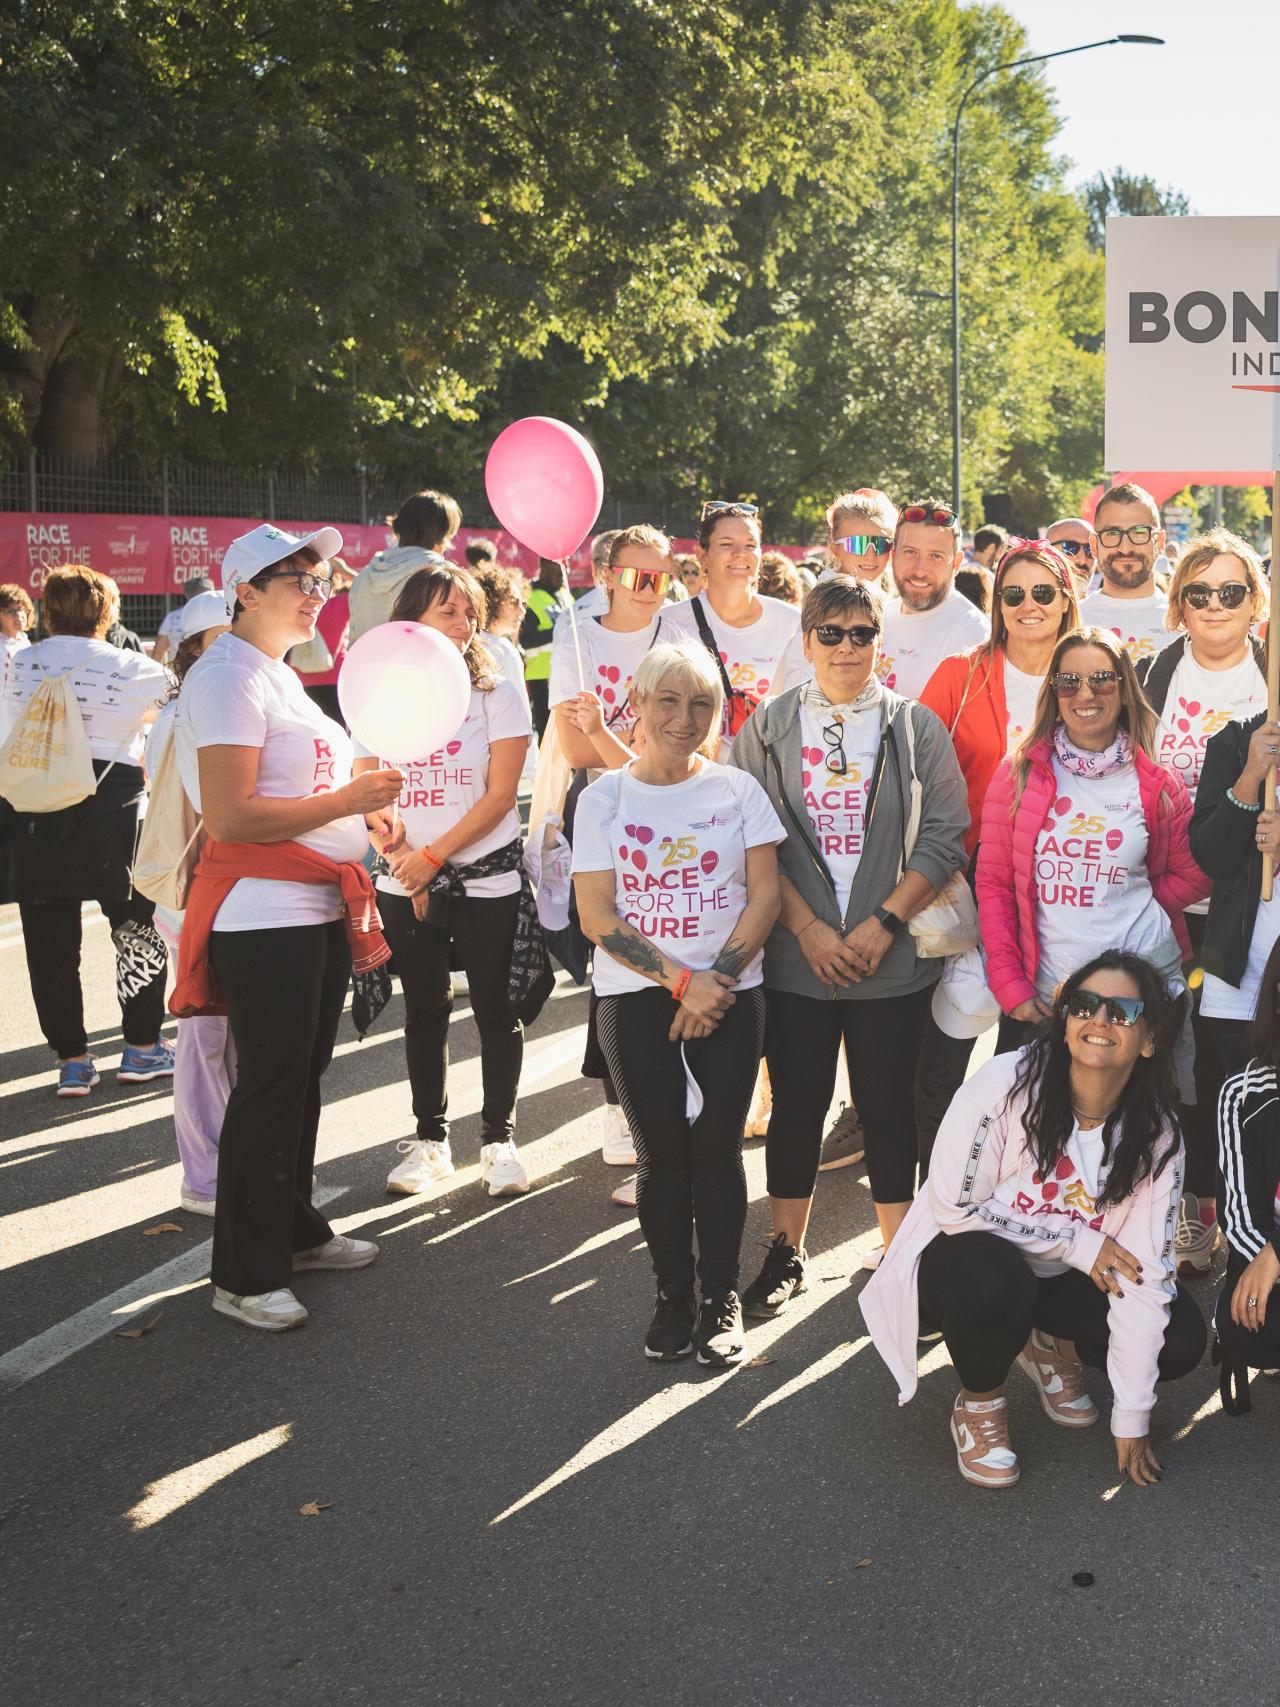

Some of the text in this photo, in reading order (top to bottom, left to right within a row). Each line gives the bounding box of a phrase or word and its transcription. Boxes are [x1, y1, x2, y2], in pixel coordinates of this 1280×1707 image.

[27, 525, 71, 545] RACE
[170, 527, 208, 546] RACE
[29, 547, 62, 567] FOR
[65, 546, 91, 565] THE
[173, 548, 224, 565] FOR THE
[728, 663, 757, 686] 25
[1161, 735, 1208, 750] RAC
[429, 768, 473, 786] THE
[398, 789, 445, 809] URE
[804, 790, 861, 811] ACE
[1068, 815, 1109, 836] 25
[658, 836, 698, 868] 25
[1034, 835, 1102, 860] ACE
[622, 866, 700, 893] RACE
[1034, 858, 1129, 885] OR THE
[626, 887, 730, 914] FOR THE
[1037, 883, 1096, 908] URE
[624, 912, 700, 939] CURE
[118, 950, 166, 1004] MAKE
[971, 1142, 981, 1161] NIKE
[964, 1174, 973, 1192] NIKE
[1063, 1183, 1096, 1214] 25
[990, 1215, 1008, 1226] NIKE
[1166, 1205, 1176, 1224] NIKE
[1163, 1240, 1172, 1258] NIKE
